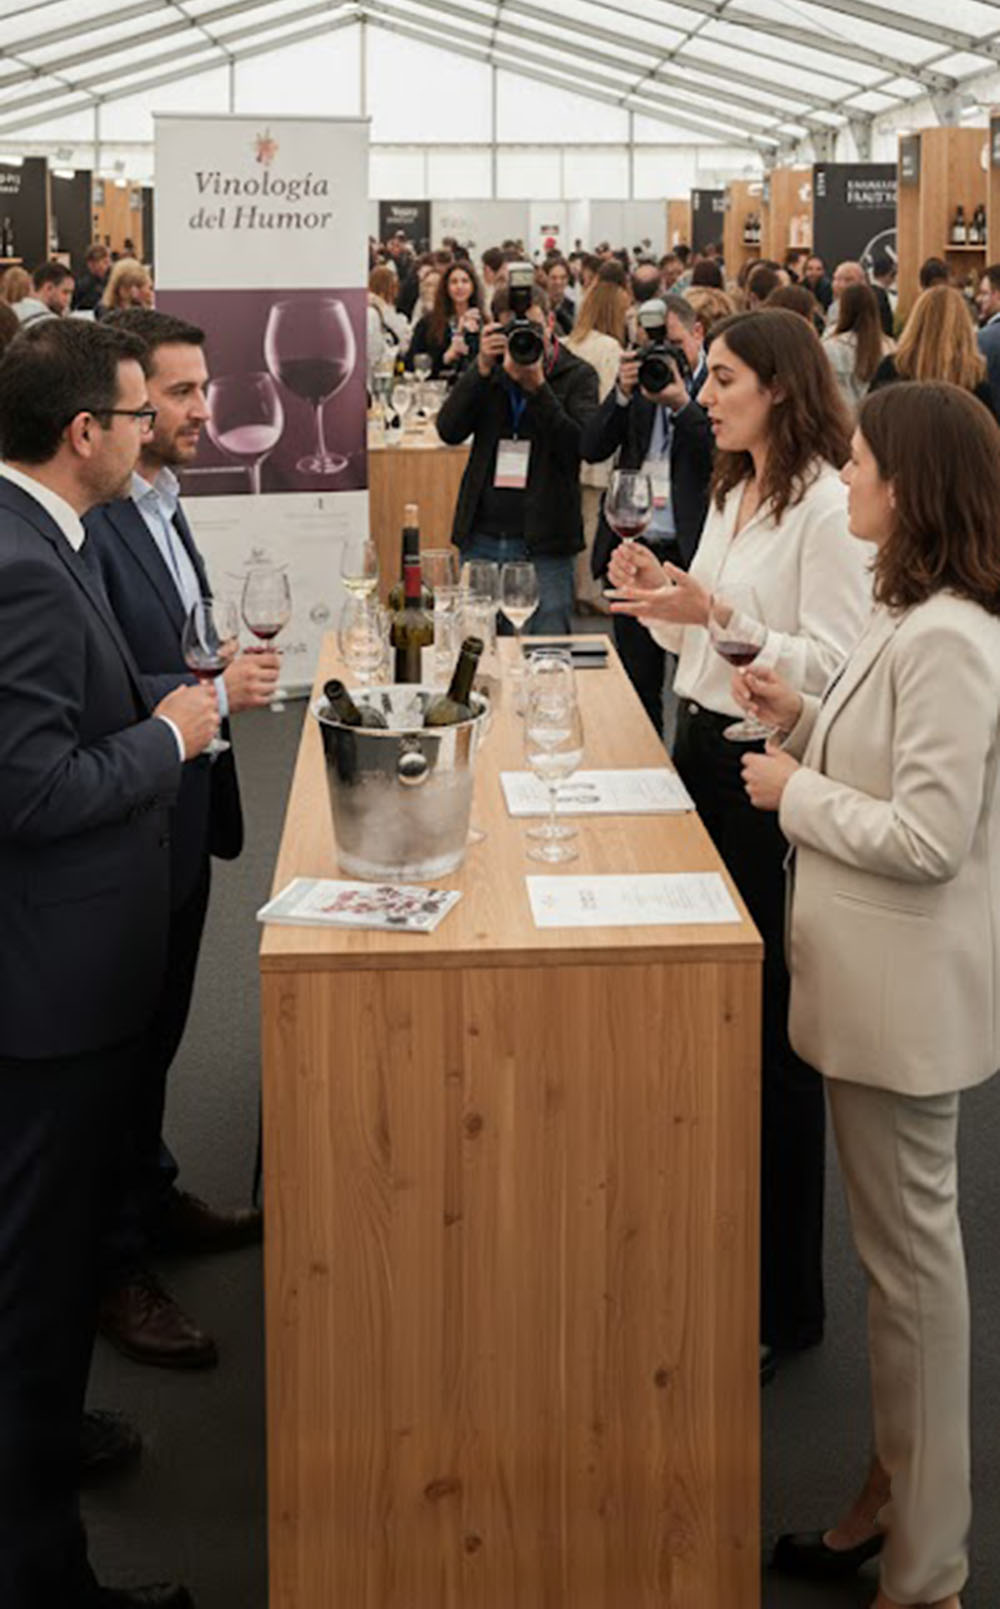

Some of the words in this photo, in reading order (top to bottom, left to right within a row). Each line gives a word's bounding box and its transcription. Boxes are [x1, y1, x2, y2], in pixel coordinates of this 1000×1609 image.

[195, 170, 329, 203] Vinología
[189, 206, 226, 229] del
[233, 205, 333, 229] Humor
